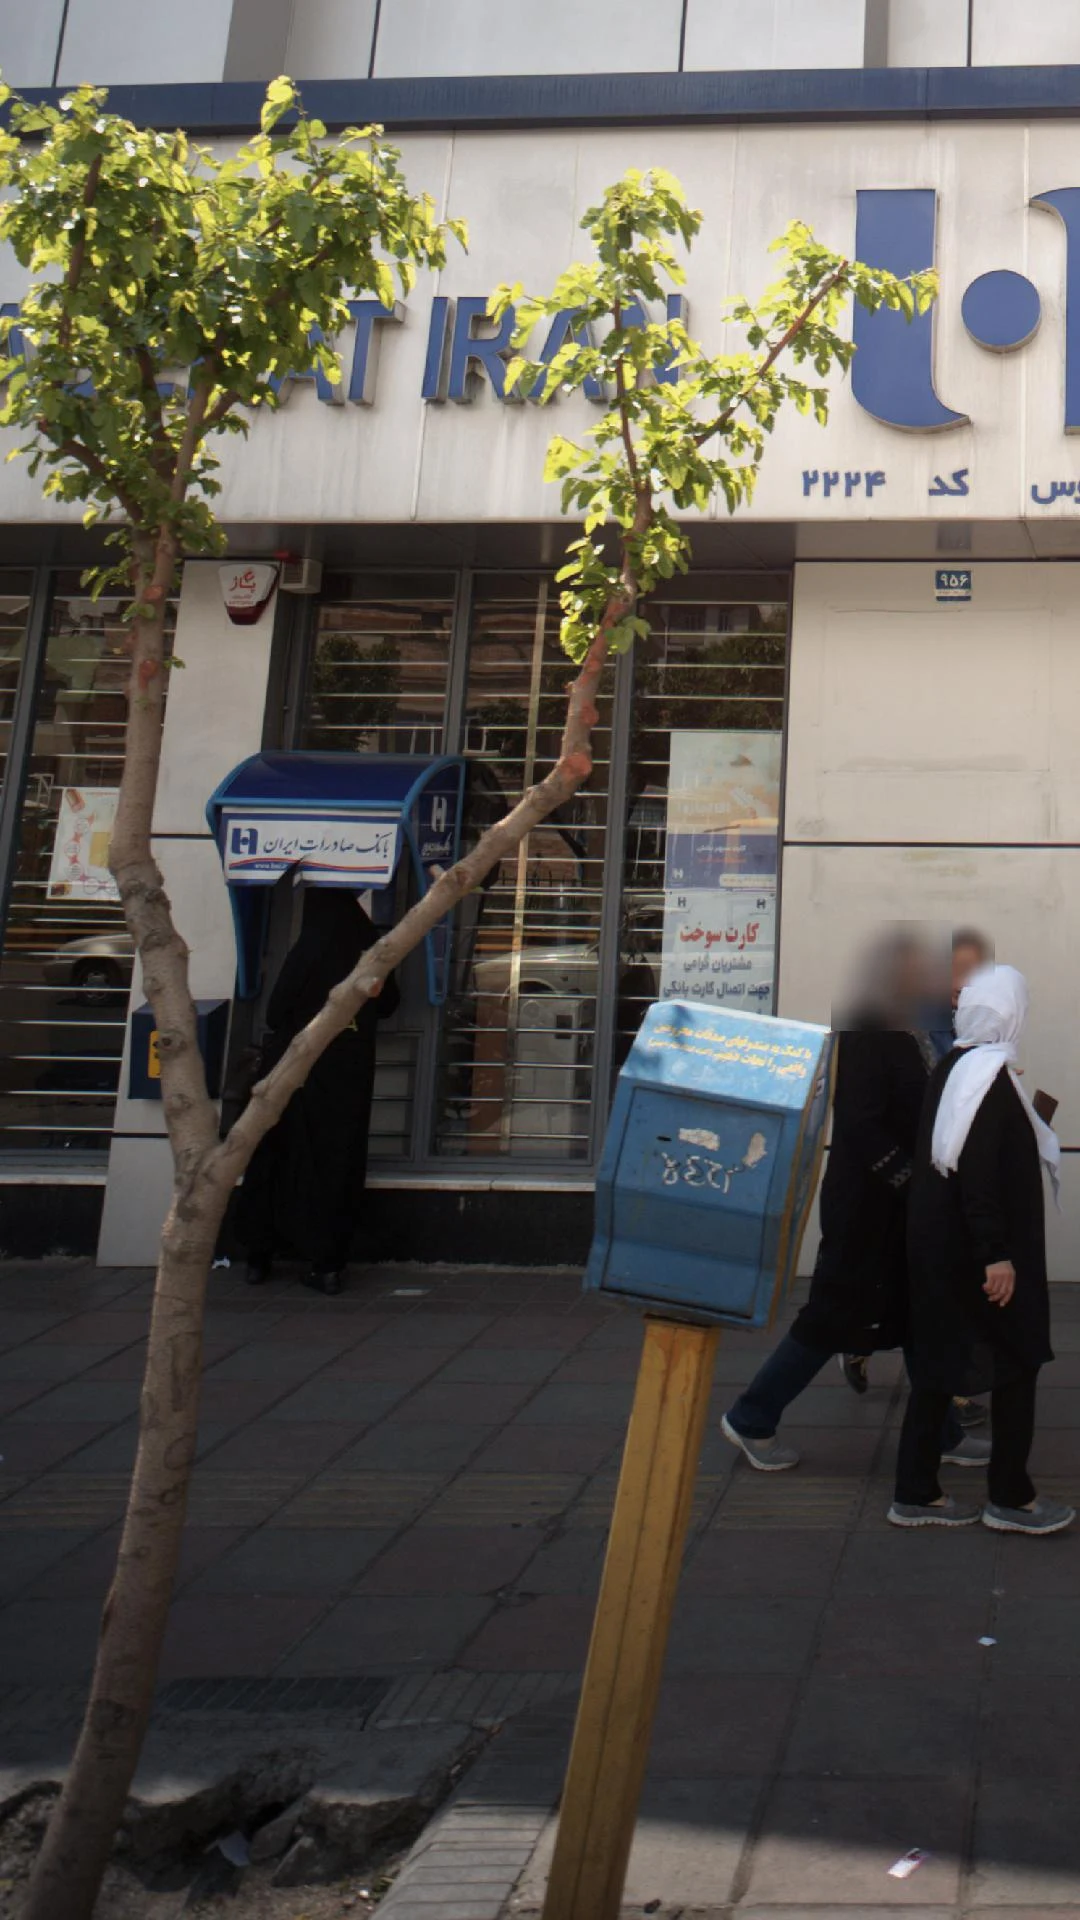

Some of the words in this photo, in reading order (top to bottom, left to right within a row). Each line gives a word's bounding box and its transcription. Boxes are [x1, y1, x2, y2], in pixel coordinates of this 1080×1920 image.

[802, 469, 887, 497] ۲۲۲۴
[928, 468, 970, 497] کد
[940, 573, 969, 587] ۹۵۶
[263, 836, 299, 855] ایران
[299, 836, 354, 853] صادرات
[355, 831, 393, 858] بانک
[680, 921, 722, 950] سوخت
[725, 922, 760, 950] کارت
[684, 953, 709, 972] گرامی
[712, 955, 753, 974] مشتریان
[663, 980, 689, 998] بانکی
[691, 981, 715, 998] کارت
[717, 983, 745, 999] اتصال
[747, 983, 771, 1000] جهت
